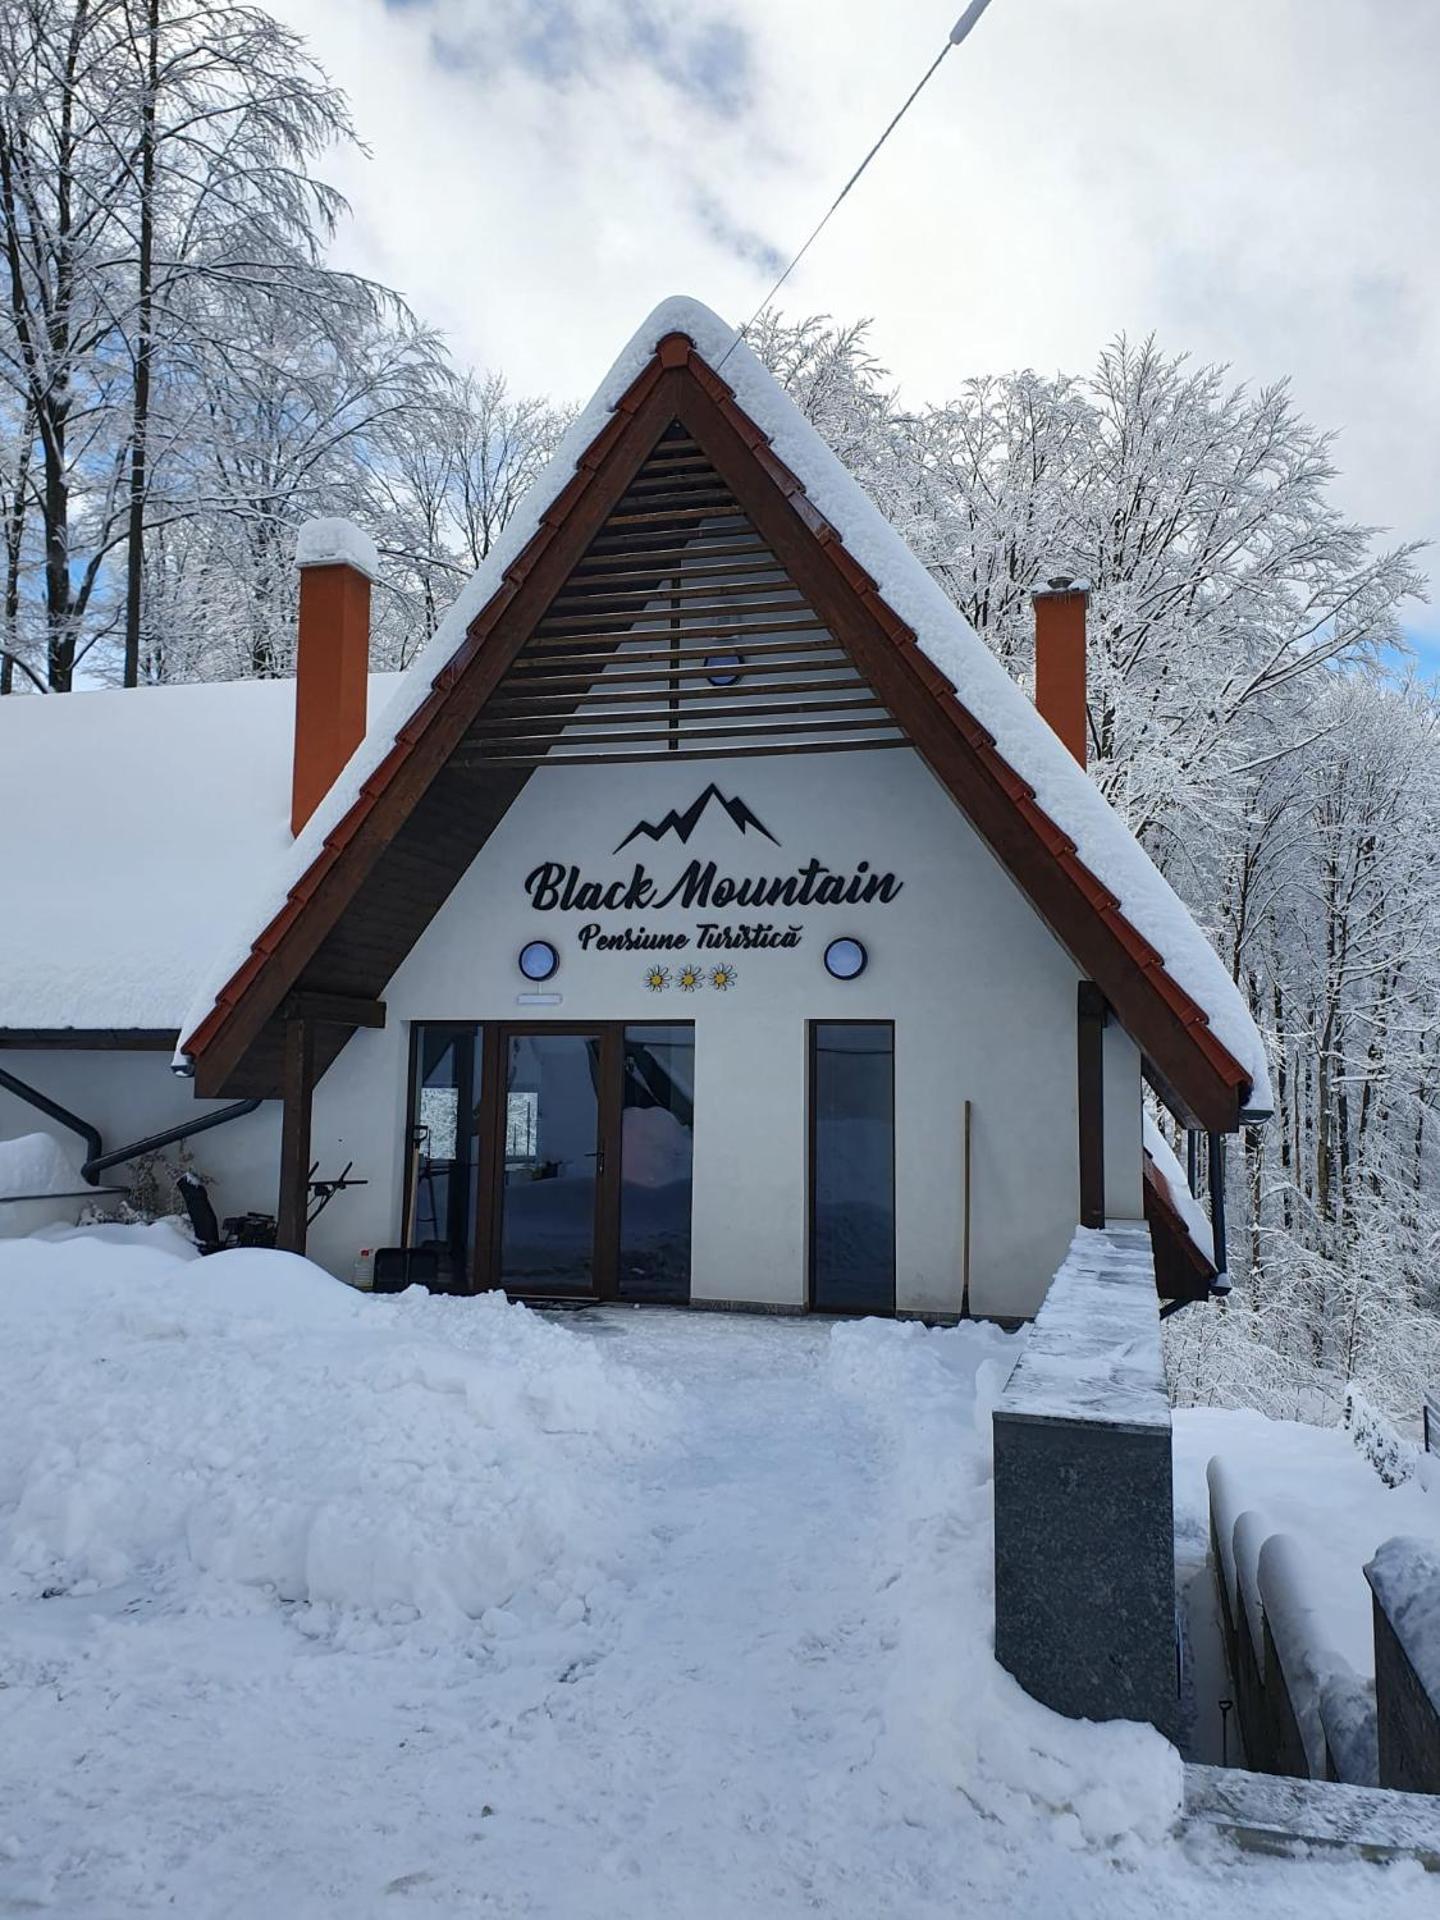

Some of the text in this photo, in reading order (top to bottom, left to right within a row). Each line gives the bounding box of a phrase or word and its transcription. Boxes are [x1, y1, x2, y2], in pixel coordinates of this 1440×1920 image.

[524, 857, 904, 911] Black Mountain
[578, 922, 804, 951] Pensiune Turistică
